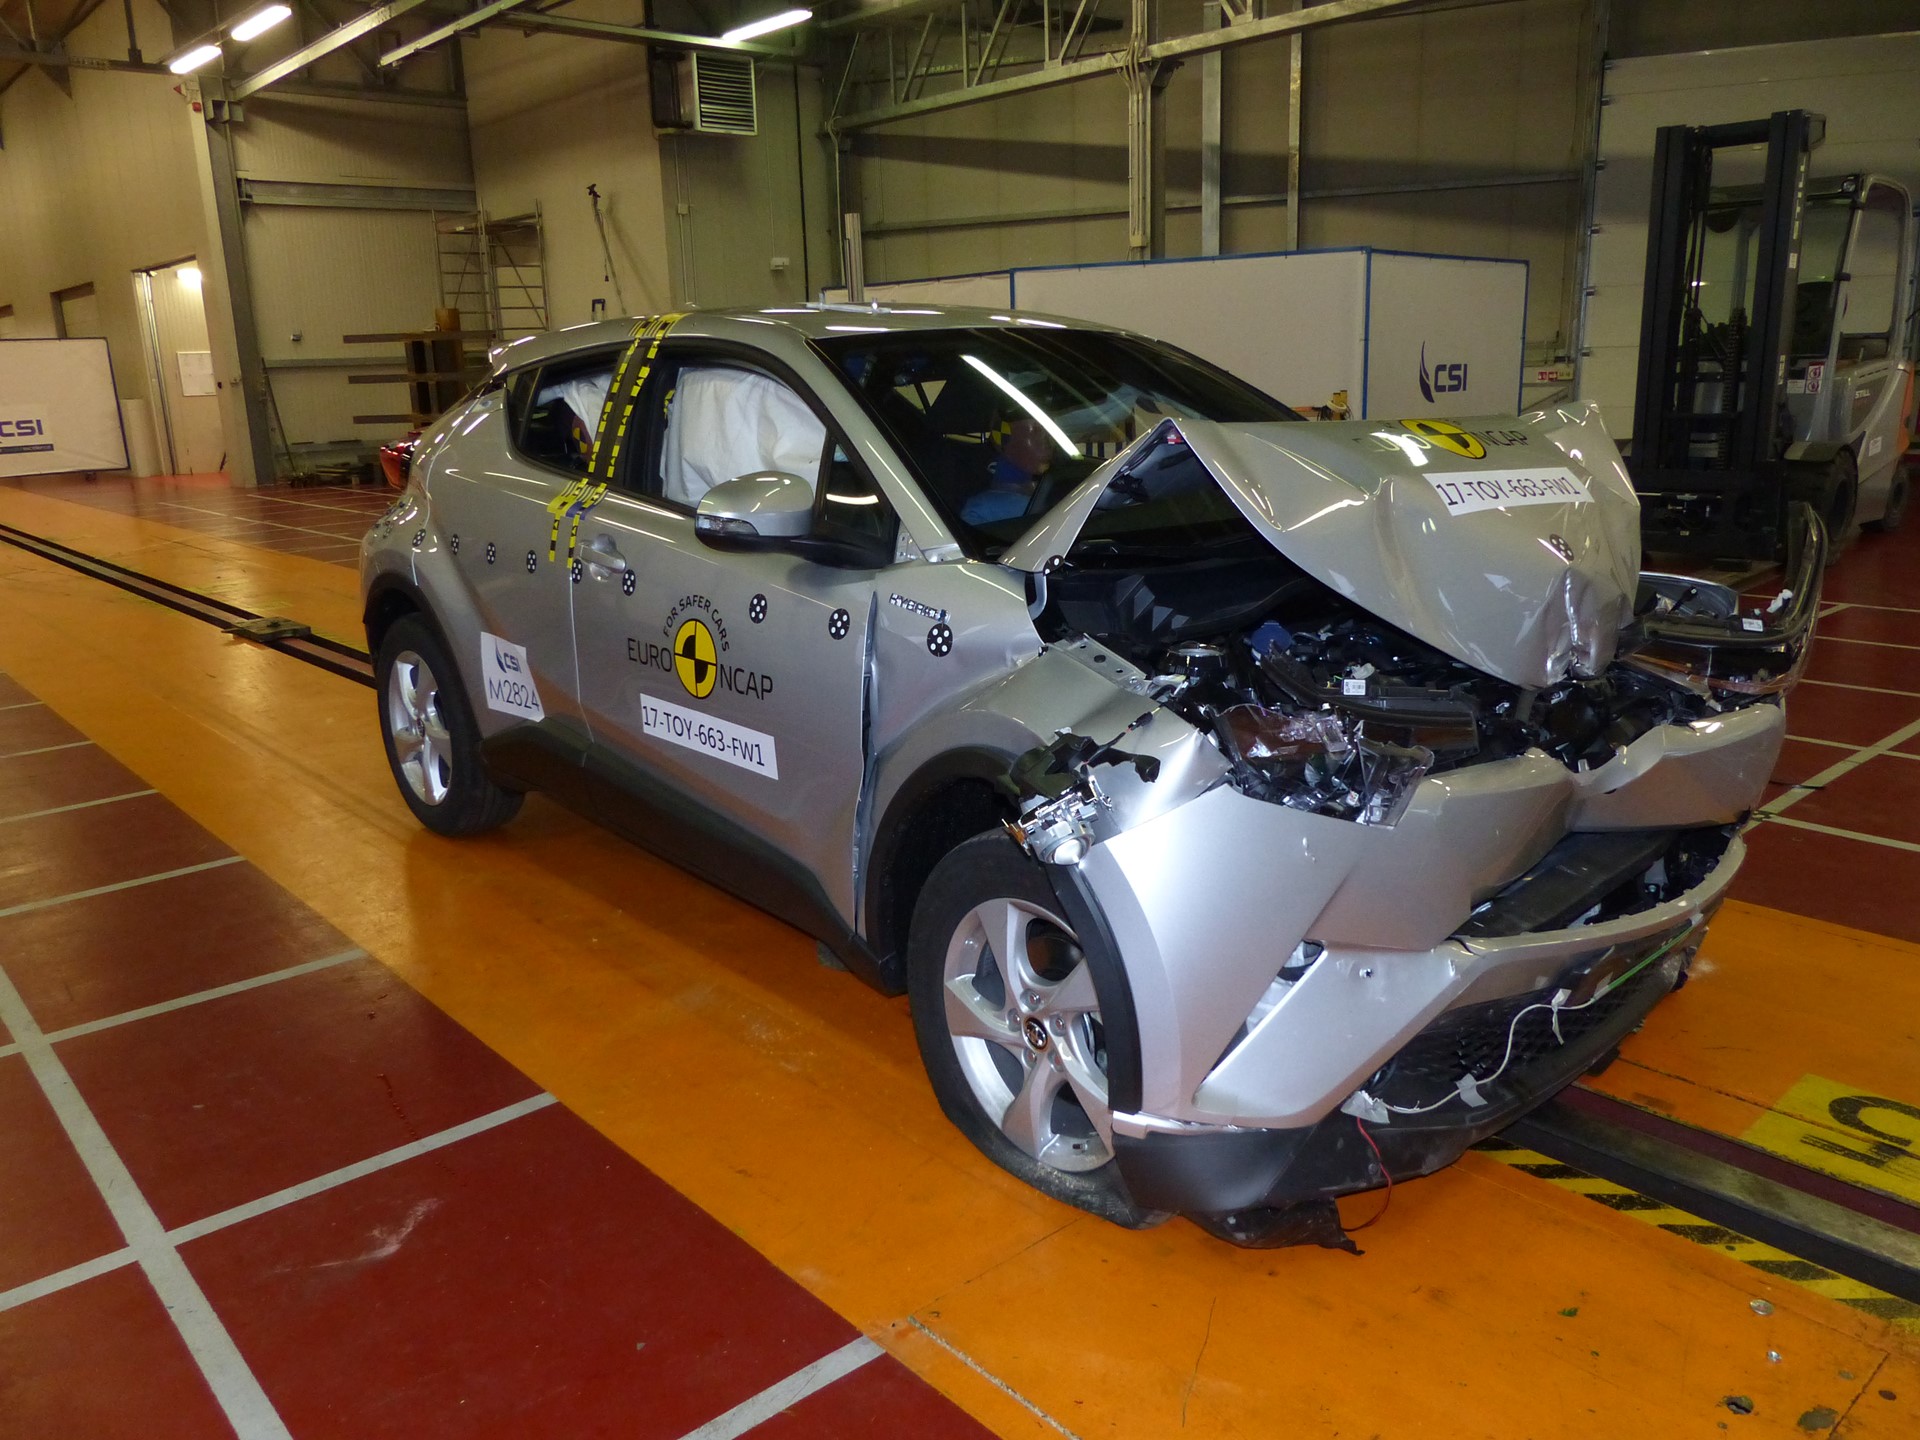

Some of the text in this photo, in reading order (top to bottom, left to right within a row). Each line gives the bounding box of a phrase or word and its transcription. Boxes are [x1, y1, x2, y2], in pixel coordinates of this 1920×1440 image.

[1434, 364, 1467, 392] CSI
[0, 419, 43, 437] CSI
[1469, 430, 1528, 446] NCAP
[1436, 477, 1580, 505] 17-TOY-663-FW1
[663, 595, 730, 651] FOR SAFER CARS
[627, 638, 773, 700] EURO NCAP
[489, 677, 540, 711] M2824
[643, 706, 765, 766] 17-TOY-663-FW1
